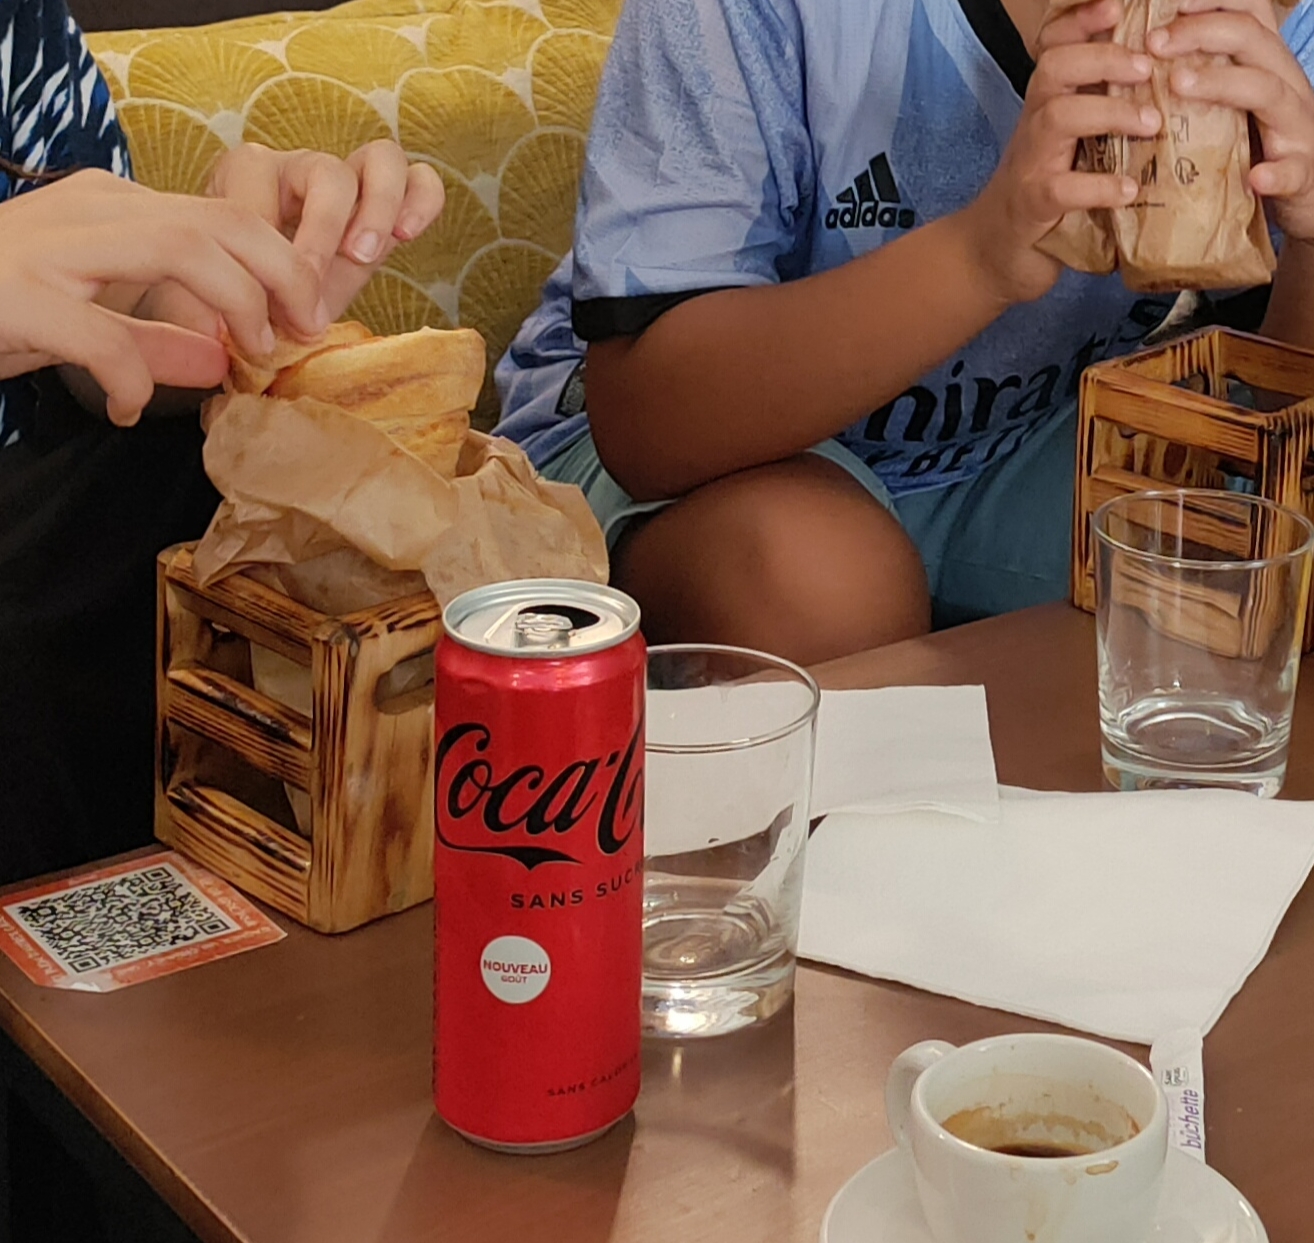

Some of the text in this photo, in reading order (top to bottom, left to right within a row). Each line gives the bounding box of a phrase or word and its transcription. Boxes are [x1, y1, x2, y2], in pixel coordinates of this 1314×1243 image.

[825, 199, 915, 230] adidas
[510, 859, 644, 910] SANS SUCR
[482, 959, 549, 975] NOUVEAU
[546, 1081, 586, 1097] SANS
